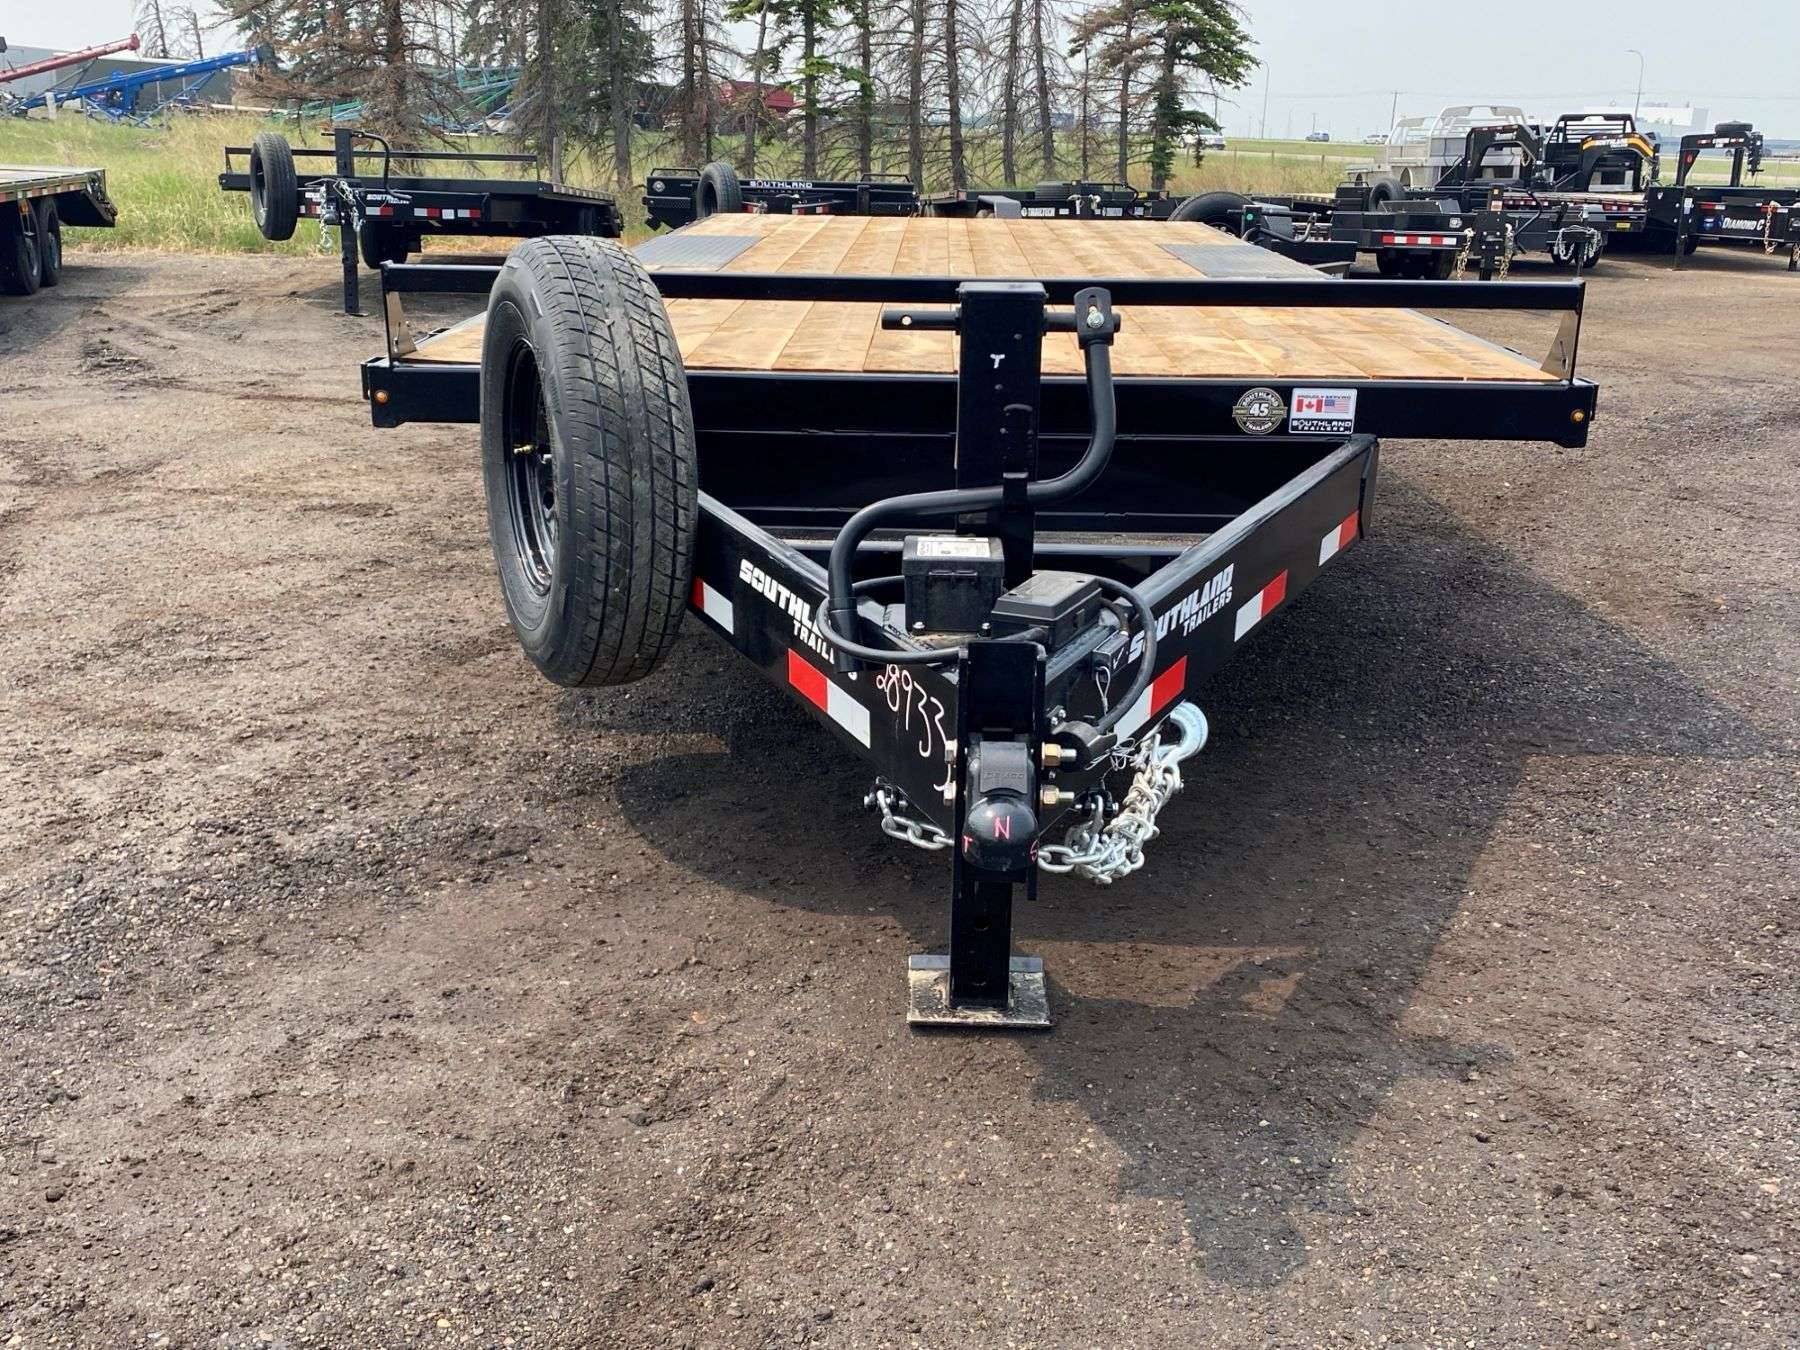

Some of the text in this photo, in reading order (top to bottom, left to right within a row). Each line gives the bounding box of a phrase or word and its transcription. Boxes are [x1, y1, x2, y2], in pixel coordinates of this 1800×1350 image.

[750, 180, 813, 189] SOUTHLAND
[1721, 217, 1765, 231] DIAMOND C
[990, 353, 1006, 369] T
[1242, 392, 1279, 407] SOUTHLAND
[1250, 403, 1269, 416] 45
[1292, 419, 1352, 428] SOUTHLAND
[739, 558, 825, 639] SOUTHL
[1128, 563, 1234, 664] SUTHLAND
[1183, 586, 1233, 637] TRAILERS
[994, 815, 1011, 840] N
